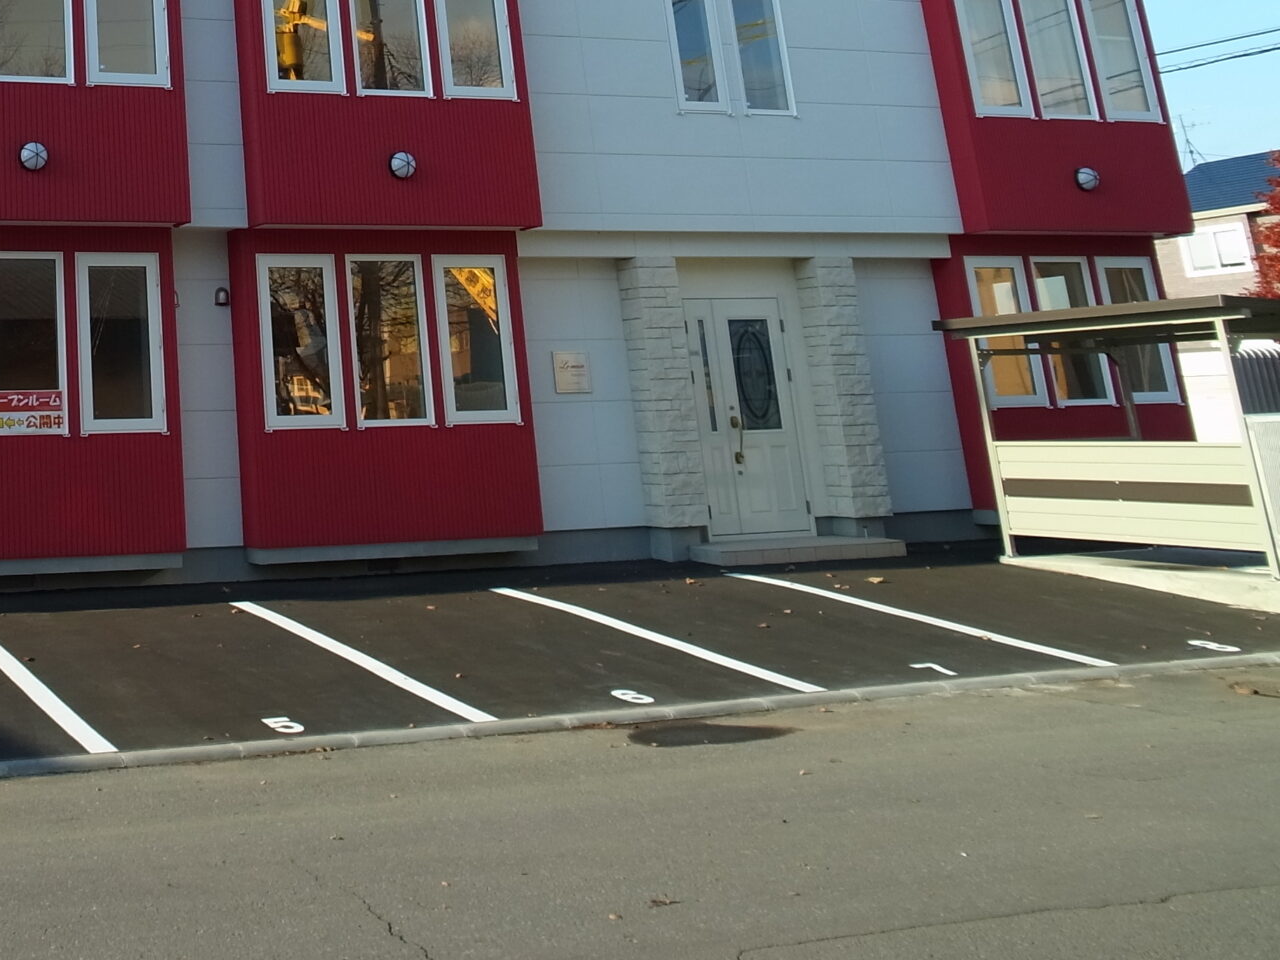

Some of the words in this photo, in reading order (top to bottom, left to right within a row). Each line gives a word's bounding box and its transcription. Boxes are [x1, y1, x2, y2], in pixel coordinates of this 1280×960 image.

[25, 414, 64, 429] 公開中
[909, 662, 958, 676] 7
[611, 689, 654, 704] 6
[261, 717, 304, 734] 5
